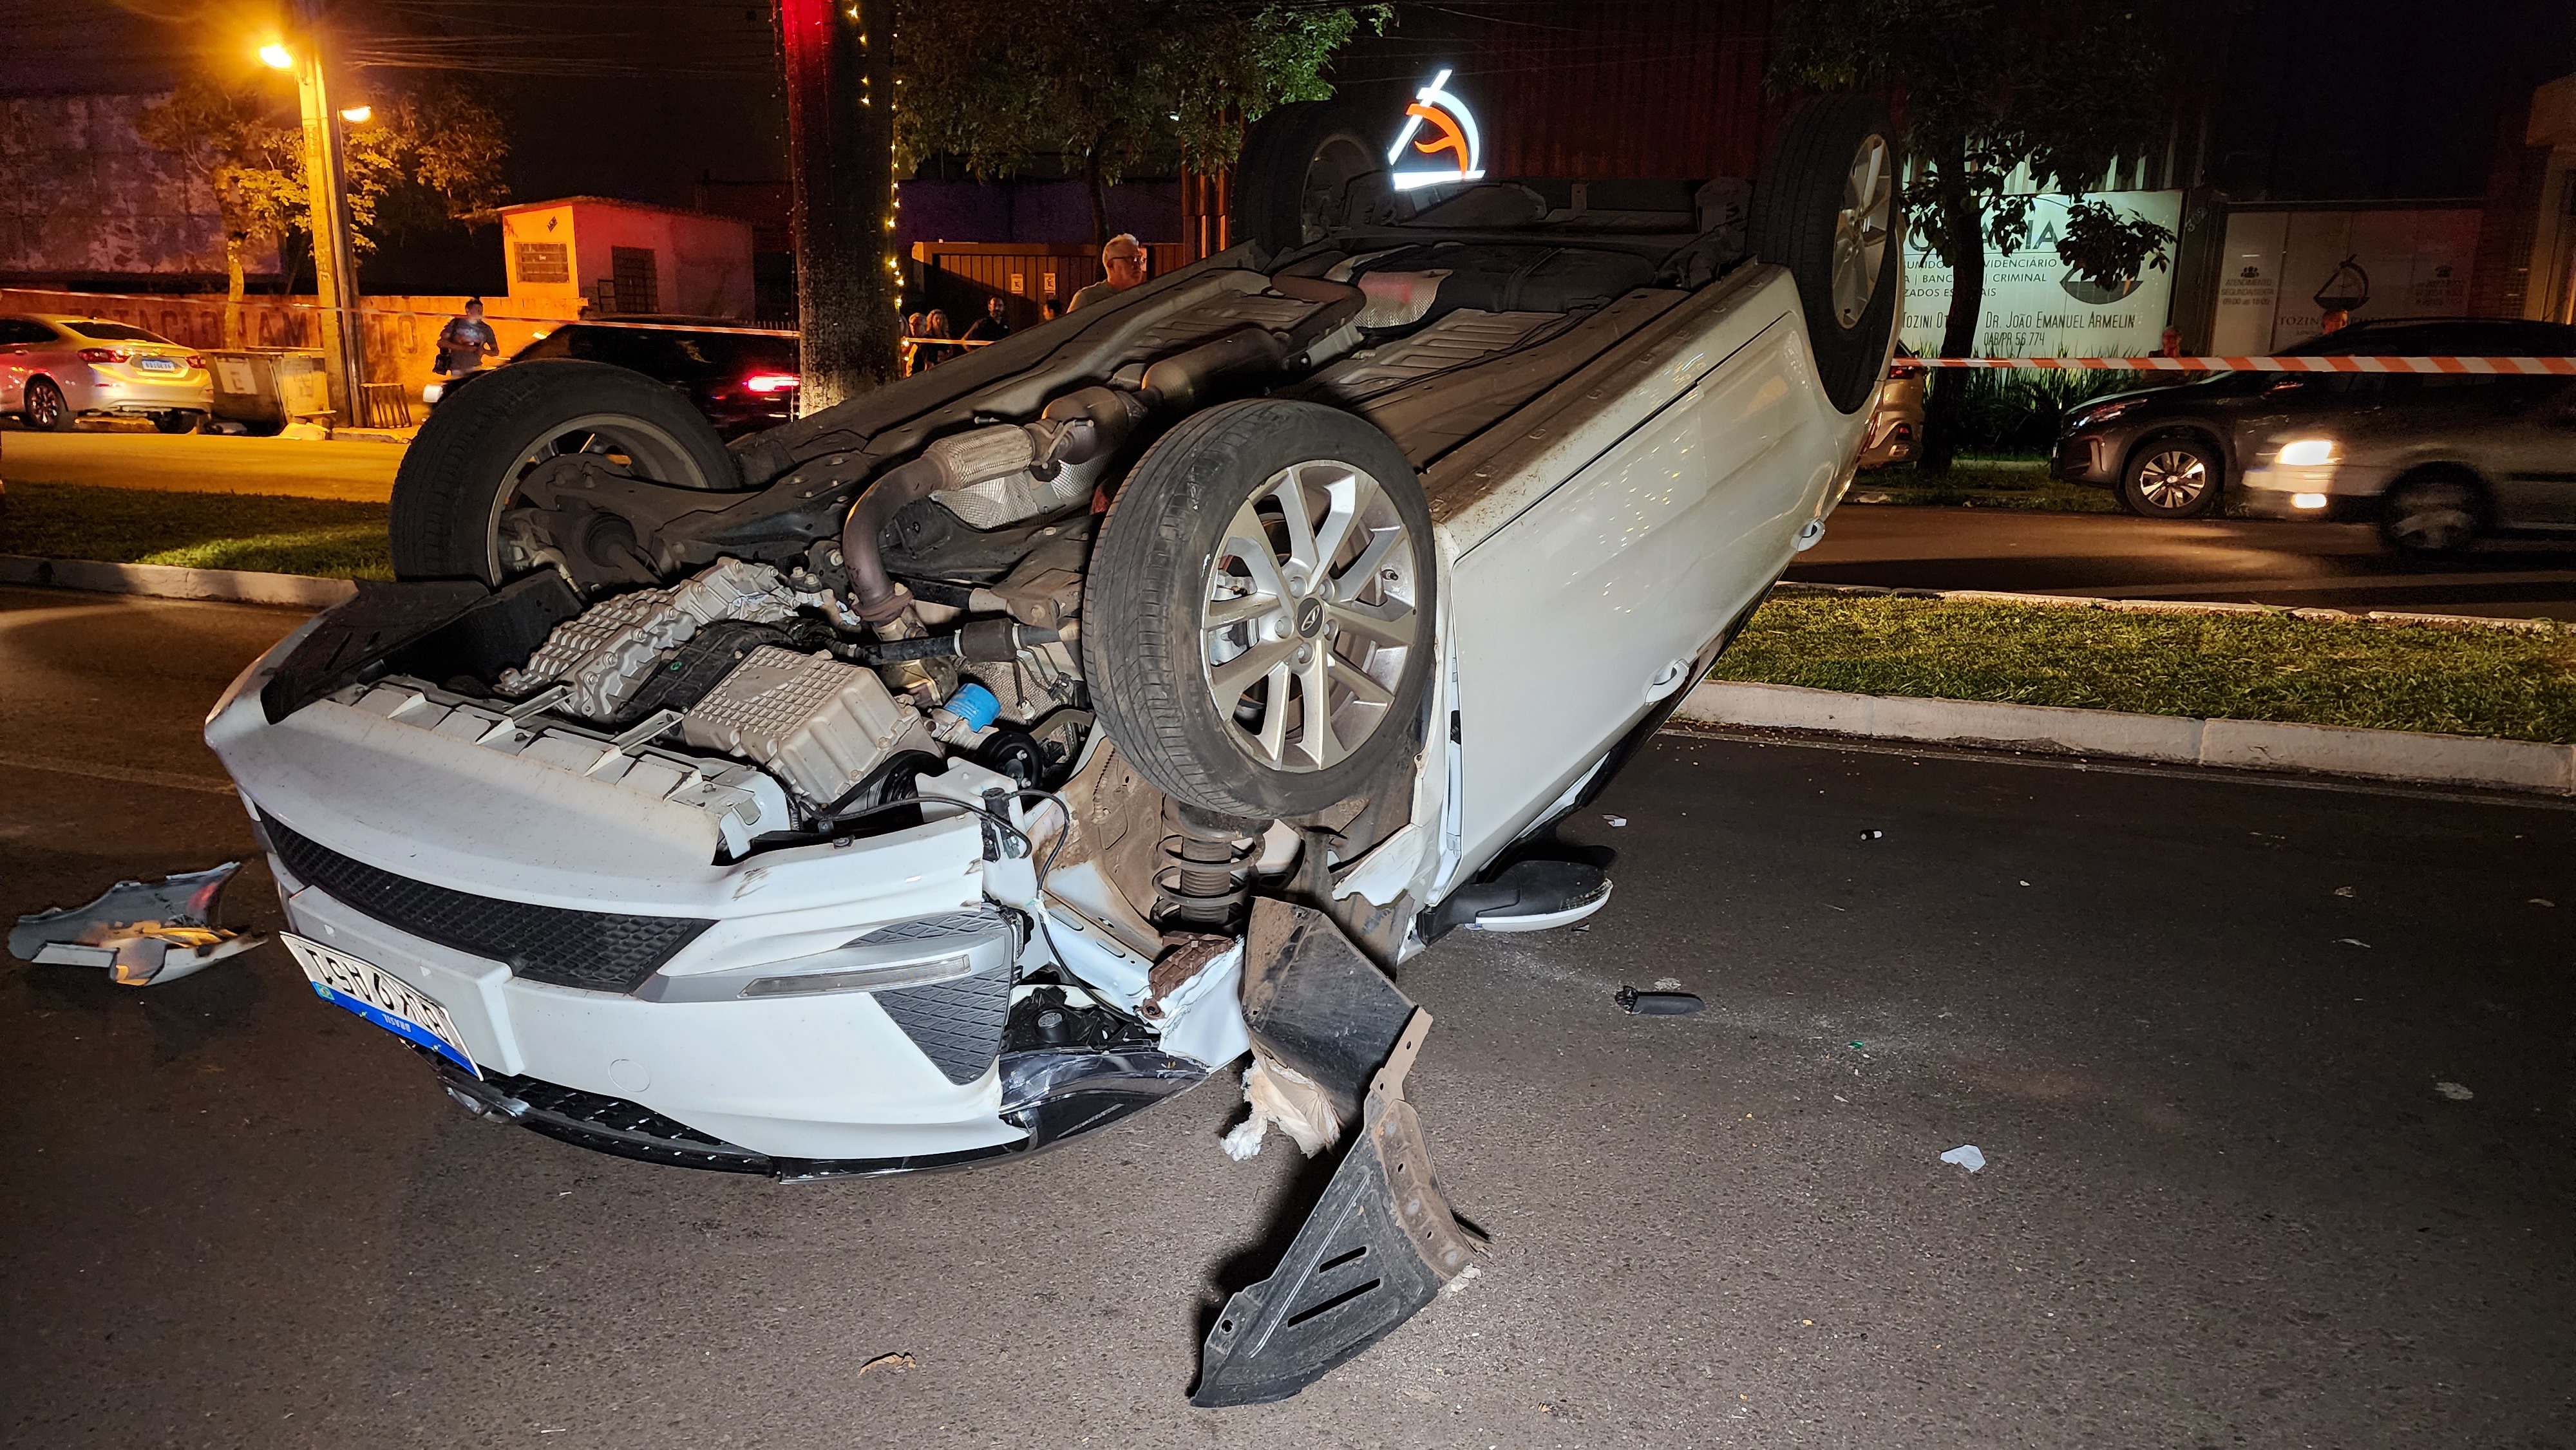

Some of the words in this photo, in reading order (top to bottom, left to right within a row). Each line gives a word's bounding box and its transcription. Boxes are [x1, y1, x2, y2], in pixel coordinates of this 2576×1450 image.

[1984, 256, 2057, 268] VIDENCIÁRIO
[1922, 274, 1953, 283] BANC
[1993, 273, 2047, 283] CRIMINAL
[1904, 288, 1940, 297] ZADOS
[1985, 311, 2002, 328] DR.
[2006, 311, 2032, 329] JOÃO
[2036, 311, 2085, 329] EMANUEL
[2088, 311, 2136, 329] ARMELIN
[2280, 316, 2321, 325] TOZIN
[1984, 332, 2012, 346] OAB/PR
[2015, 332, 2045, 346] 56.774
[381, 1013, 412, 1033] BRASIL
